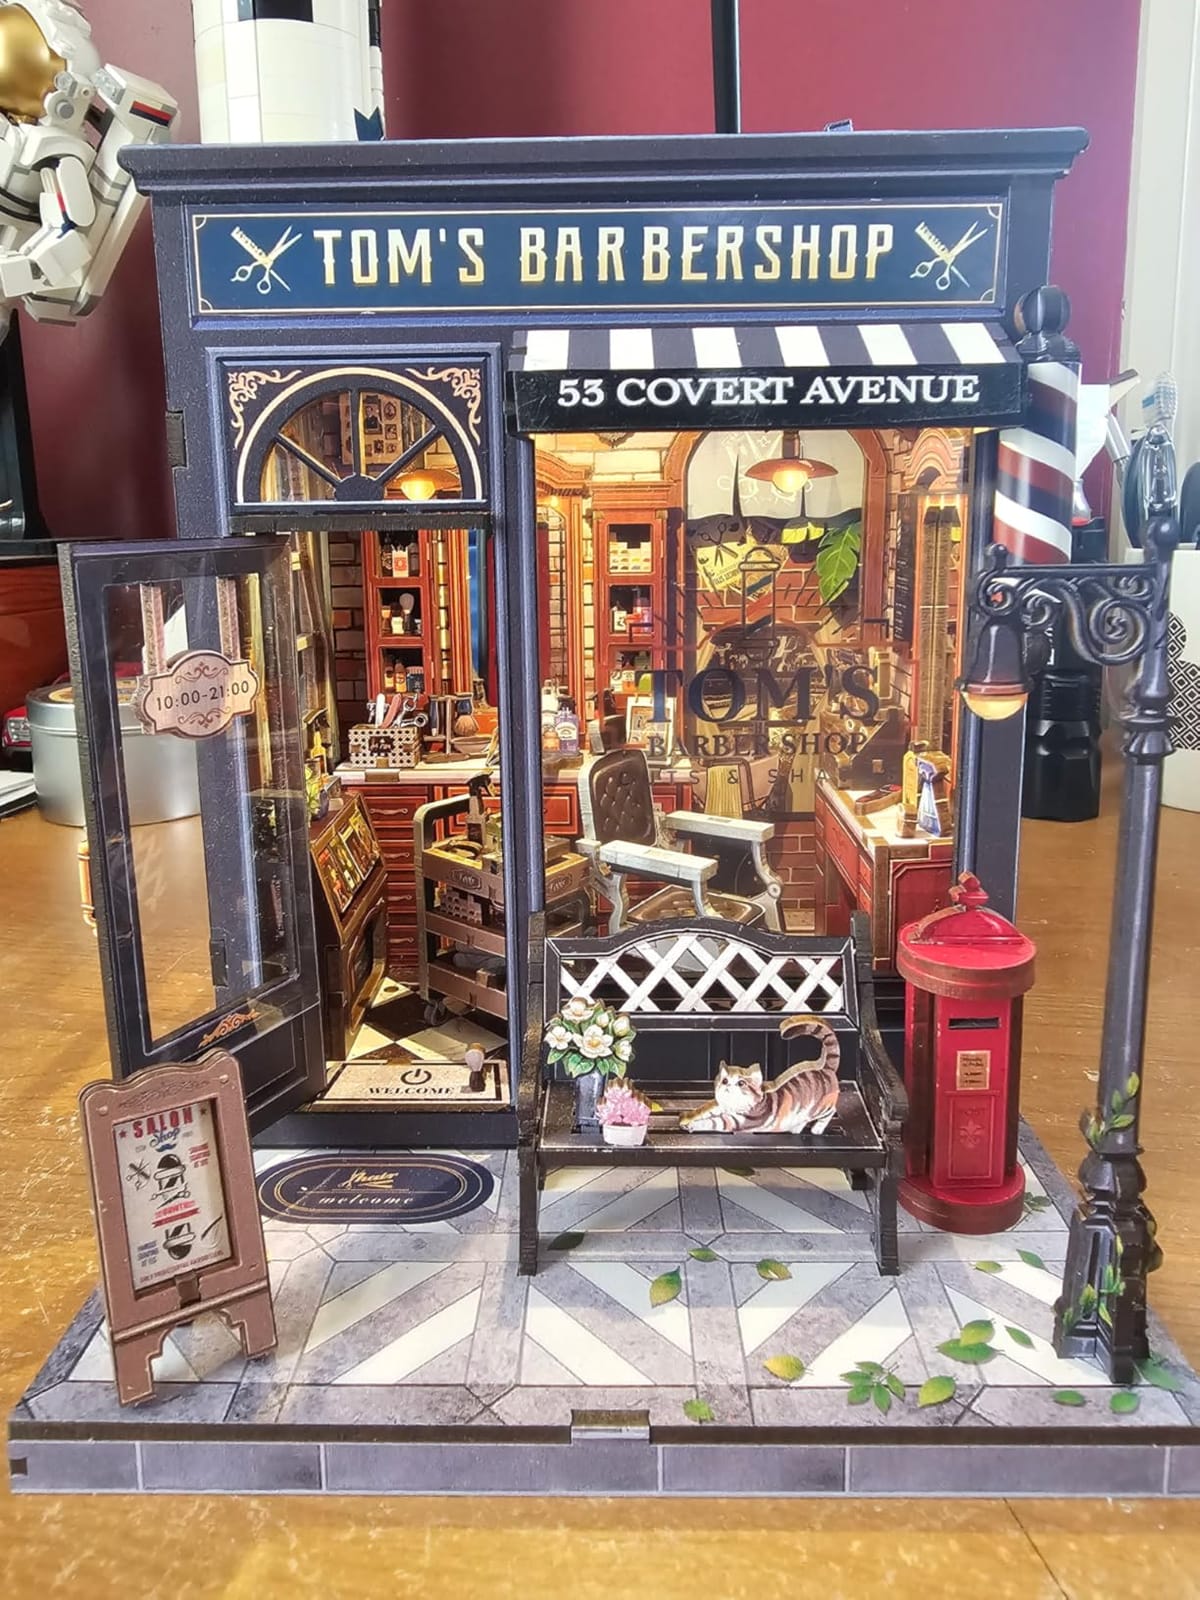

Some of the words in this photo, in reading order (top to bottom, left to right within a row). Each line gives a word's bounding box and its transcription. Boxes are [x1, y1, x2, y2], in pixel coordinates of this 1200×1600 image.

[313, 227, 486, 286] TOM'S
[519, 223, 895, 283] BARBERSHOP
[557, 377, 606, 408] 53
[616, 375, 794, 407] COVERT
[803, 374, 981, 405] AVENUE
[156, 680, 249, 711] 10:00-21:00
[634, 664, 879, 723] TOM'S
[369, 1087, 454, 1095] WELCOME
[132, 1106, 193, 1138] SALON
